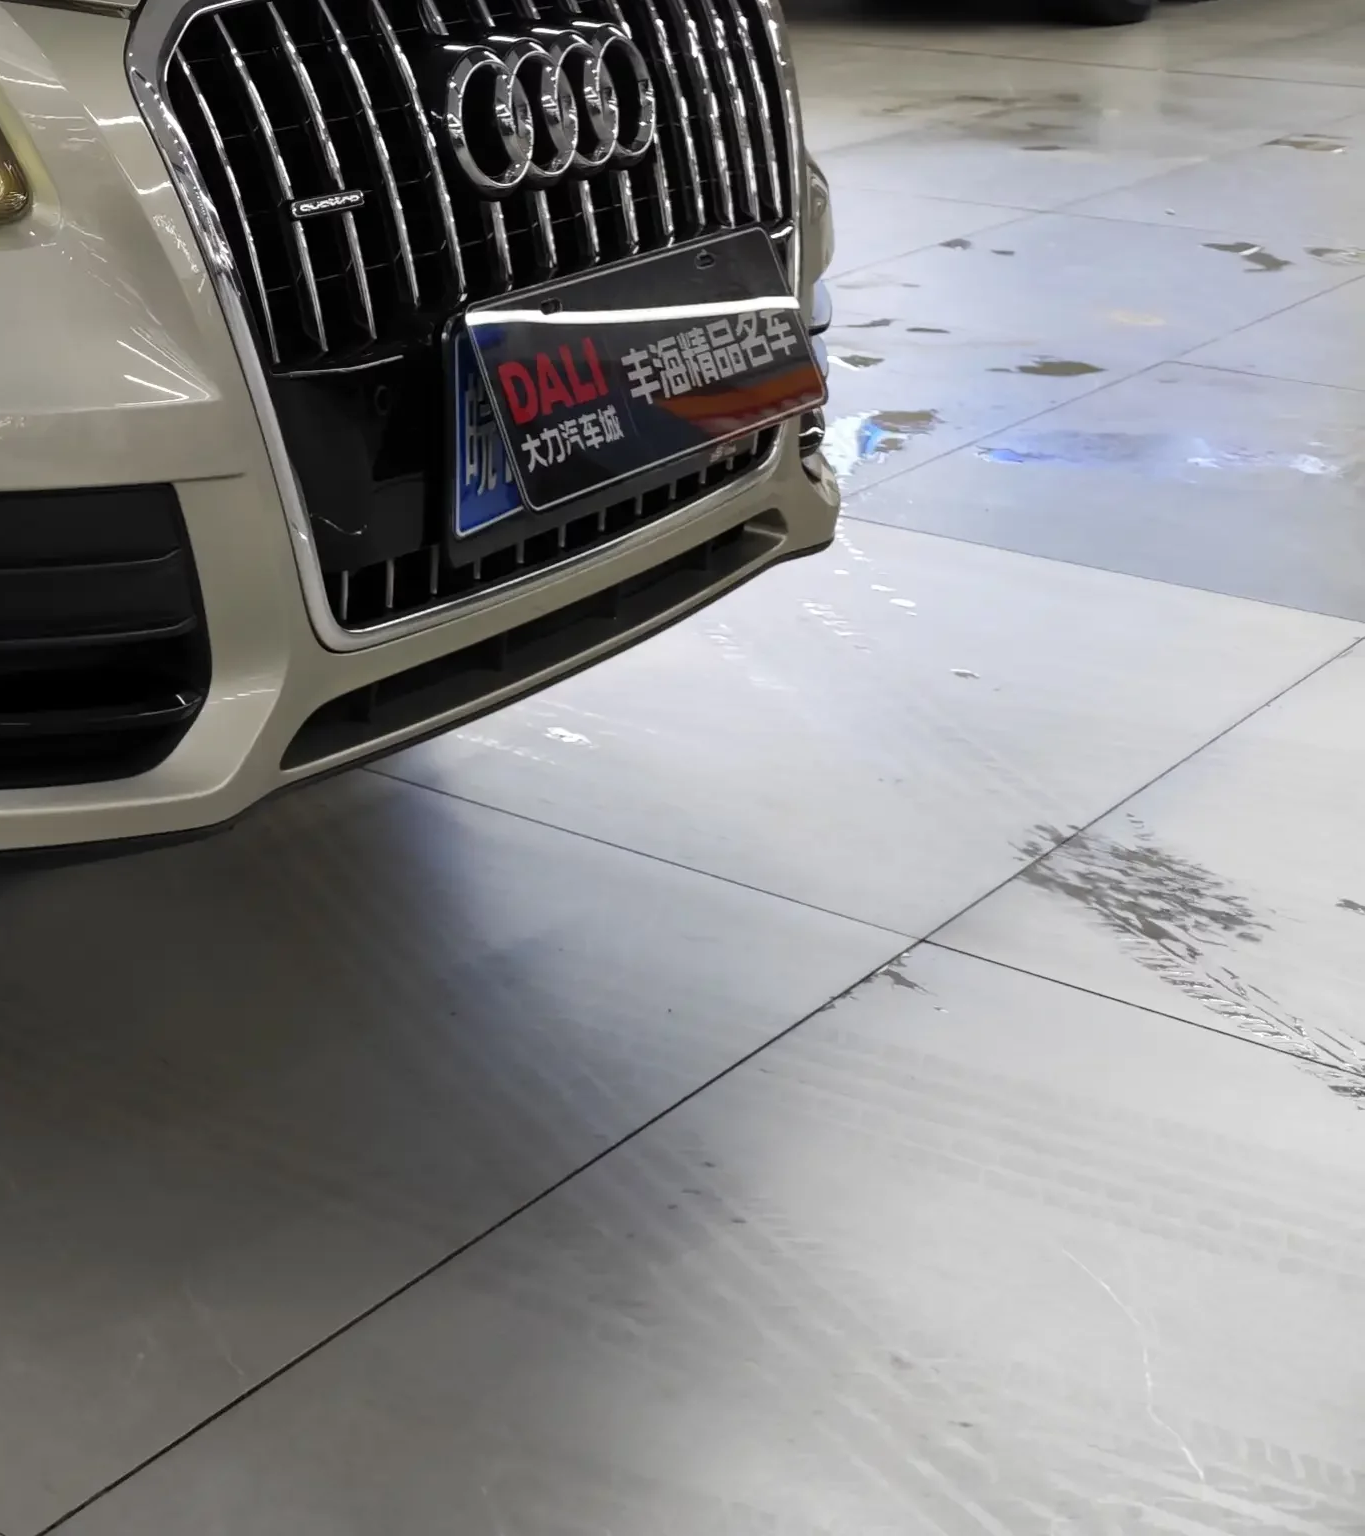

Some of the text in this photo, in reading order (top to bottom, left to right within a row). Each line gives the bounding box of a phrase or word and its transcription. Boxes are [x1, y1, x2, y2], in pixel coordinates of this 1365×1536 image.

[499, 337, 609, 426] DALI
[621, 310, 797, 405] 丰海精品名车
[521, 404, 624, 473] 大力汽车城
